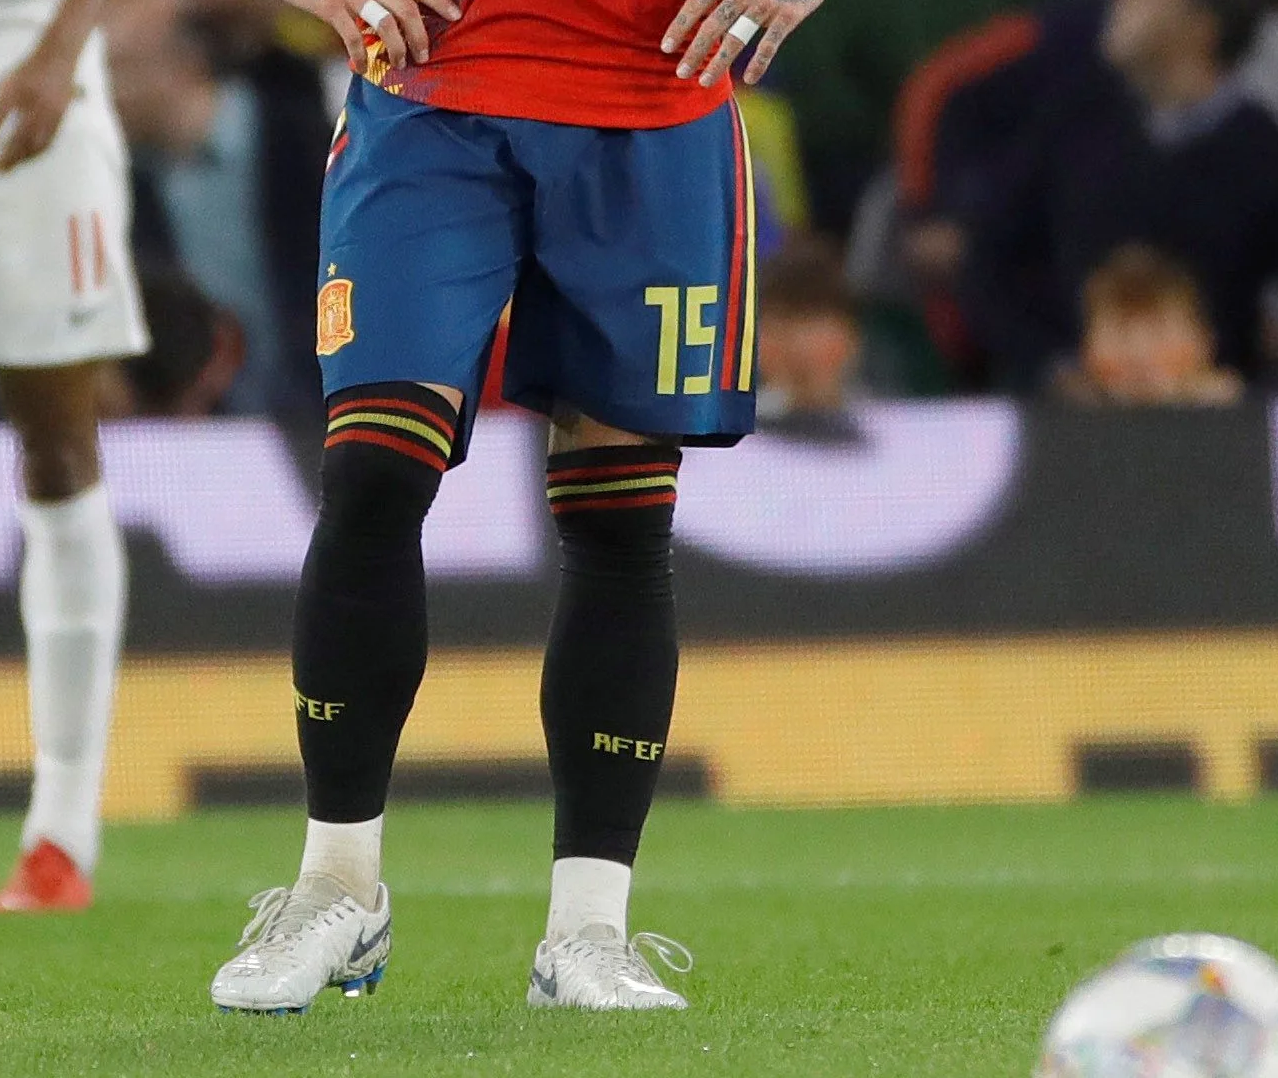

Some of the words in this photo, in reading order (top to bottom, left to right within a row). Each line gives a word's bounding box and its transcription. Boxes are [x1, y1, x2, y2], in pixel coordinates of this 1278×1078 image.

[68, 210, 109, 296] 11
[644, 285, 718, 395] 15
[295, 690, 345, 721] FEF
